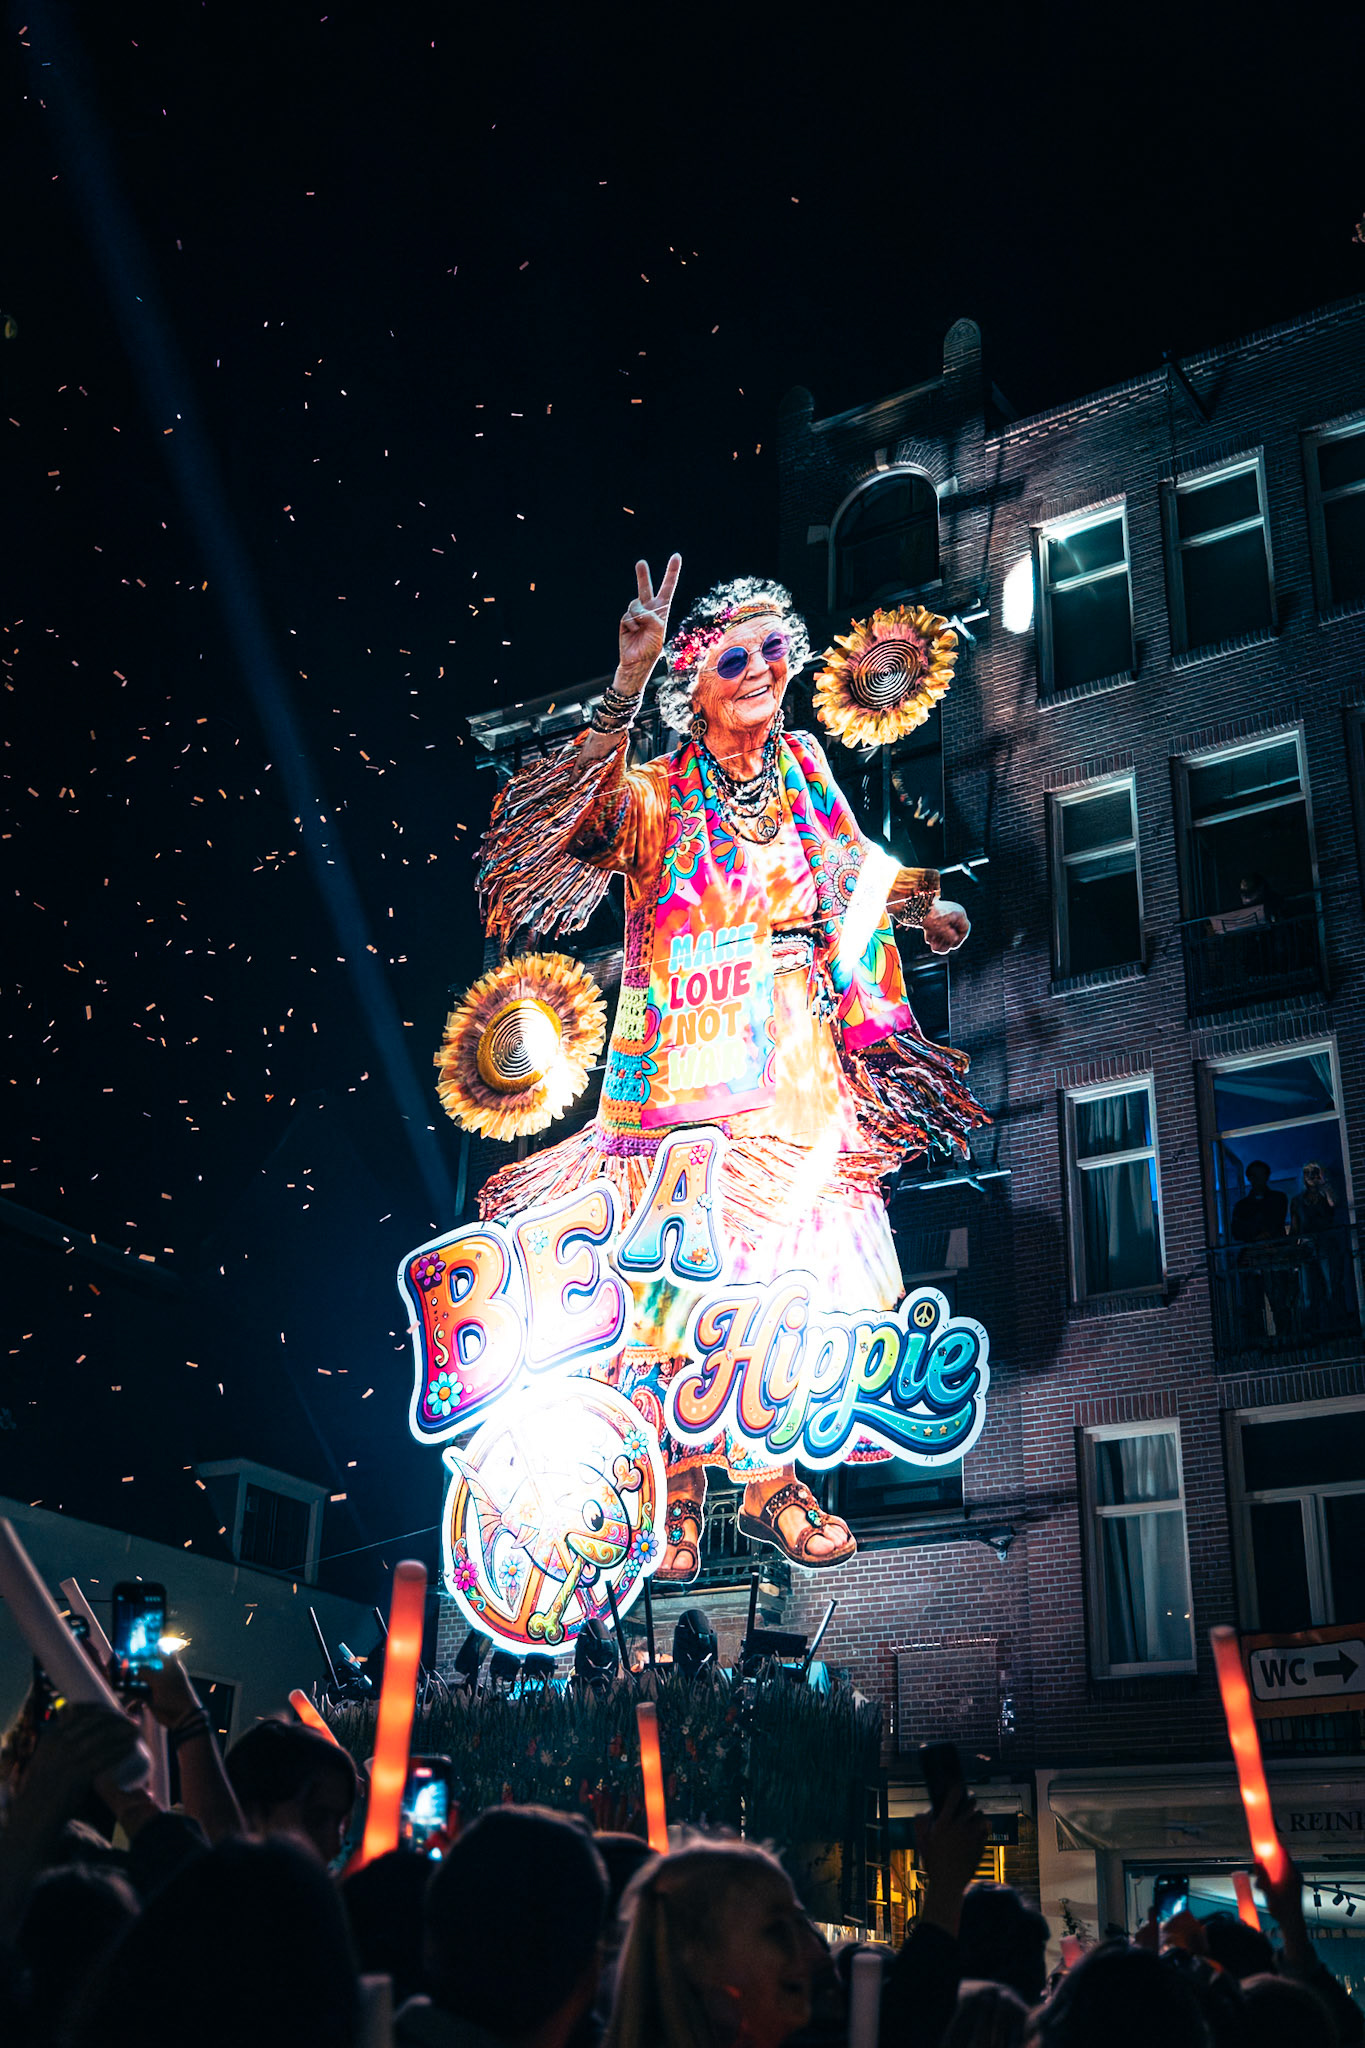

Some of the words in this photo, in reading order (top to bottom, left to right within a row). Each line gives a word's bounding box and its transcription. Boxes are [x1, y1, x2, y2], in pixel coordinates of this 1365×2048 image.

[669, 923, 757, 972] MAKE
[669, 961, 753, 1010] LOVE
[674, 1002, 742, 1046] NOT
[669, 1042, 746, 1091] WAR
[403, 1186, 626, 1434] BE
[617, 1135, 723, 1283] A
[673, 1283, 980, 1458] Hippie
[1259, 1656, 1308, 1688] WC
